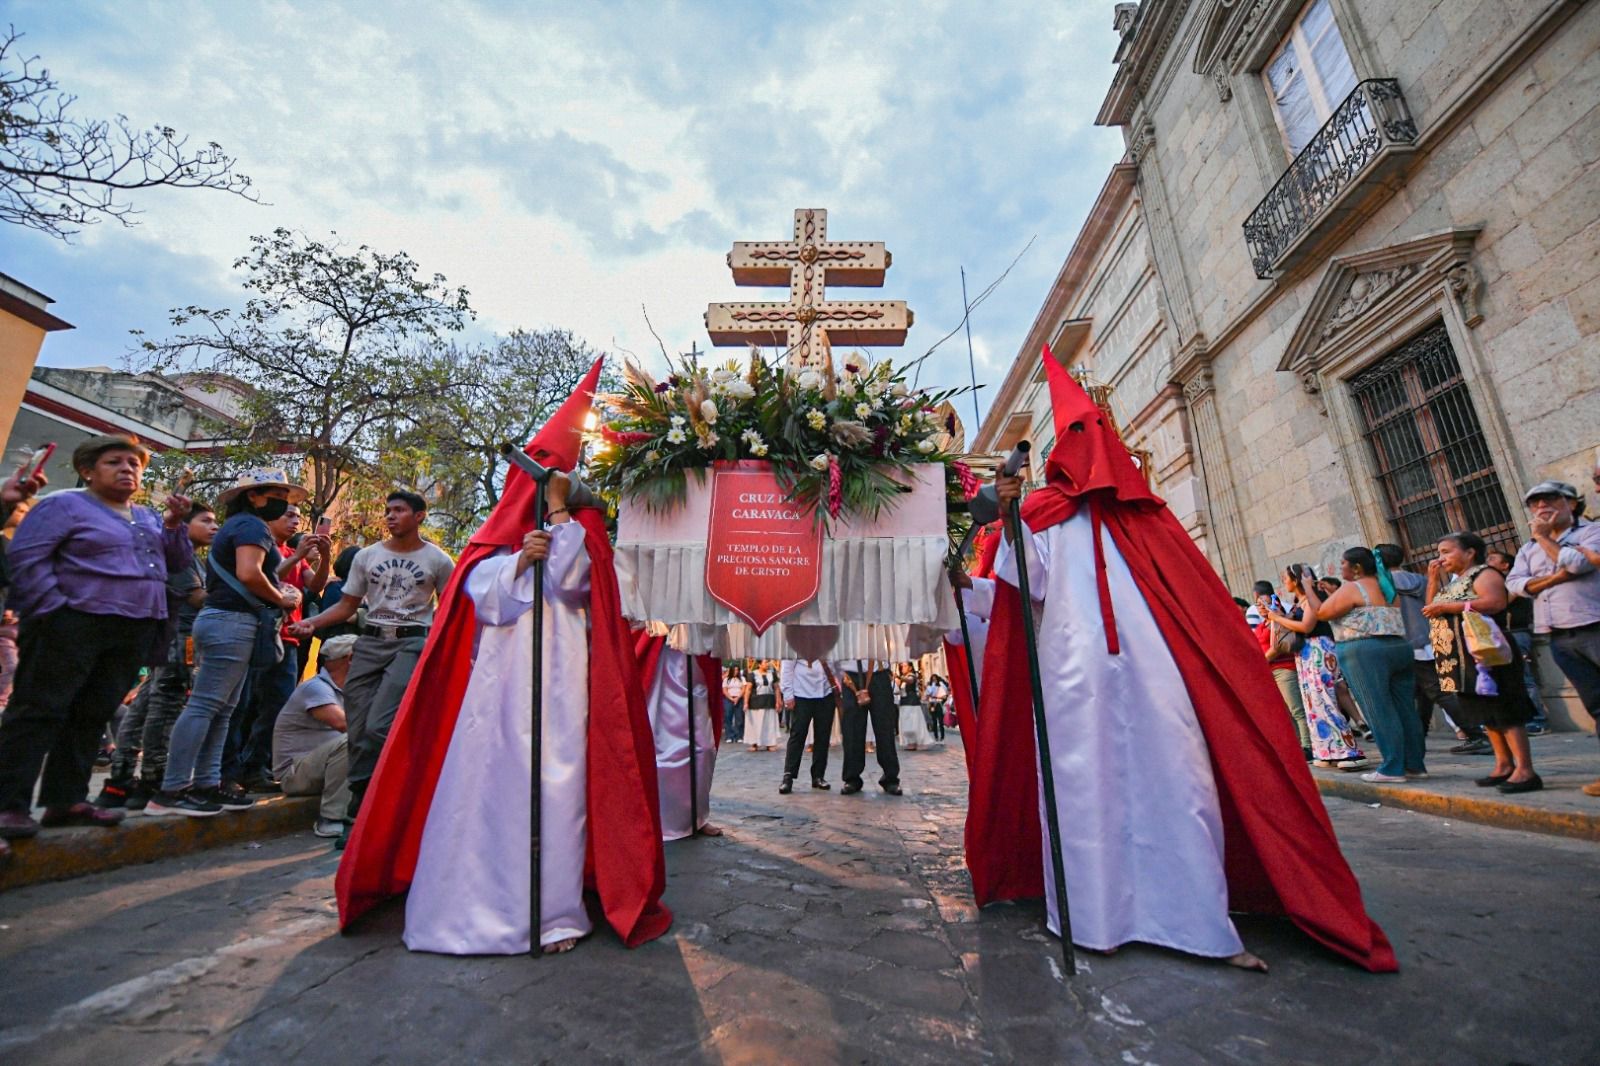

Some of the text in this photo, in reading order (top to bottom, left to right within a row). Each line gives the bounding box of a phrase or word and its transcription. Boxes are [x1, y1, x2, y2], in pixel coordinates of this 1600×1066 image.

[739, 493, 775, 503] CRUZ
[732, 509, 801, 520] CARAVACA
[727, 544, 801, 554] TEMPLO DE LA
[717, 554, 810, 566] PRECIOSA SANGRE
[370, 559, 425, 585] PENTATHLON
[735, 567, 790, 577] DE CRISTO
